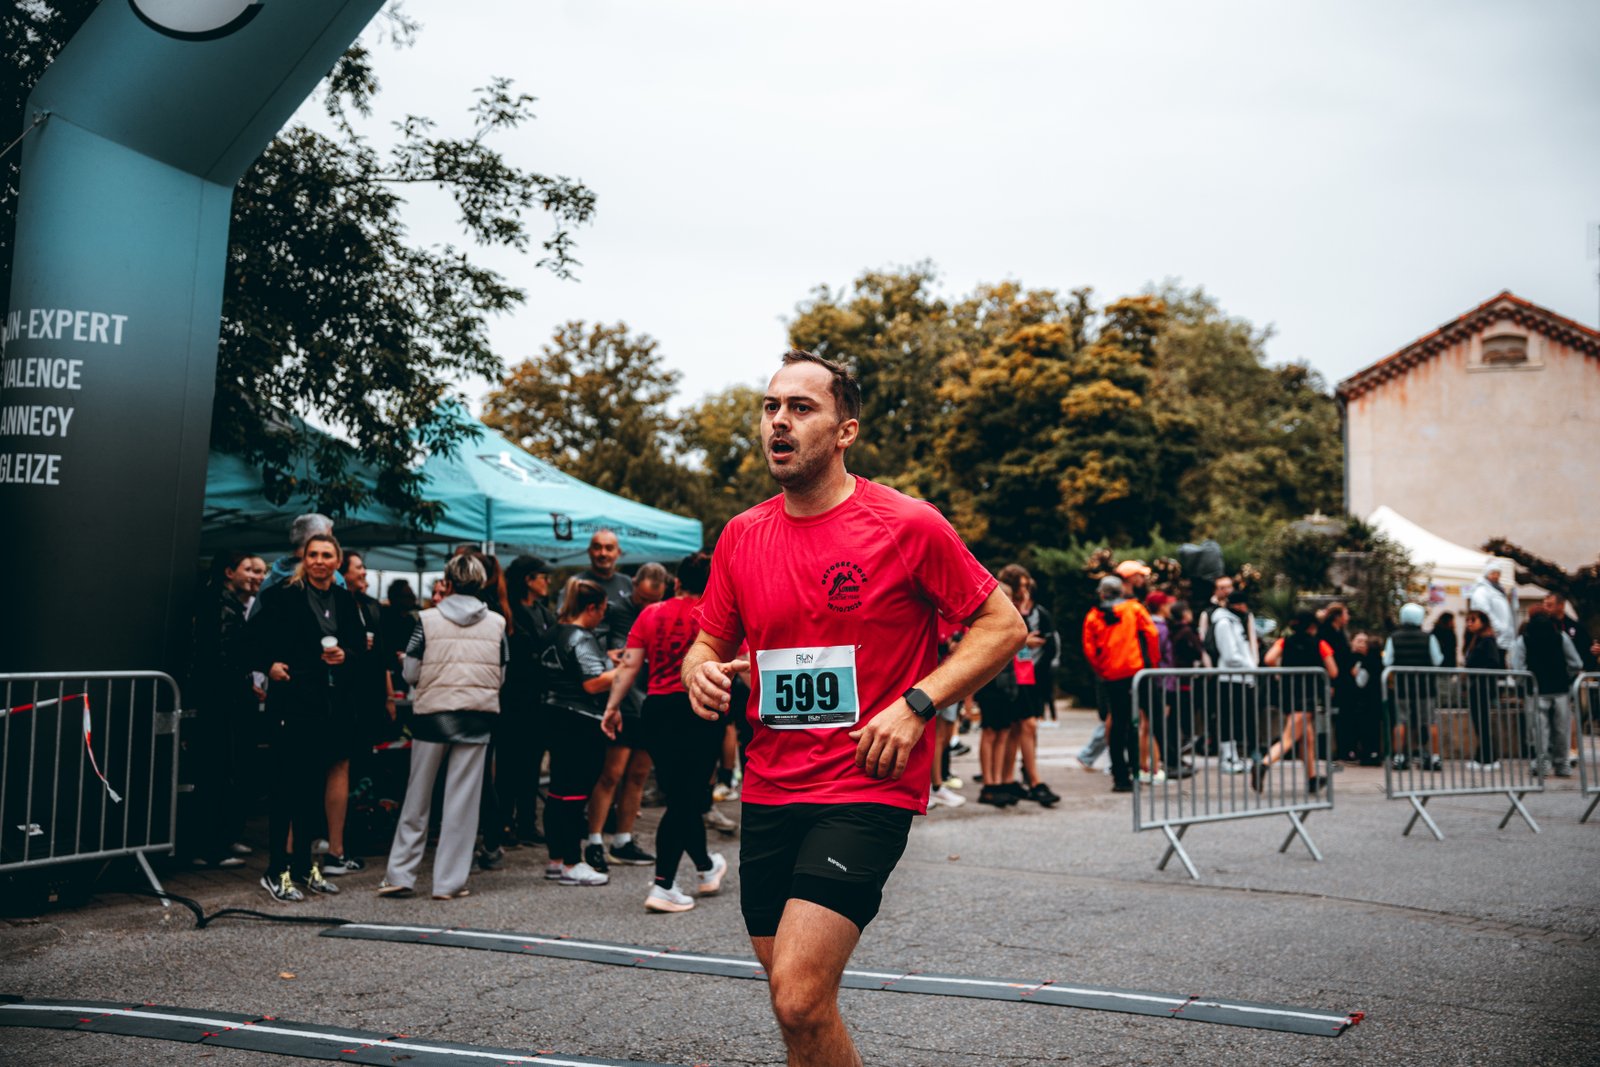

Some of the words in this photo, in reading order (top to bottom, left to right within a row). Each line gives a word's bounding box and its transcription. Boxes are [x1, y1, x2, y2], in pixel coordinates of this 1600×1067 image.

[6, 309, 128, 345] UN-EXPERT
[3, 357, 84, 390] VALENCE
[0, 405, 75, 438] ANNECY
[0, 453, 62, 486] GLEIZE
[821, 561, 851, 585] OCTOBRE
[853, 564, 868, 583] ROSE
[796, 653, 814, 661] RUN
[775, 671, 840, 713] 599
